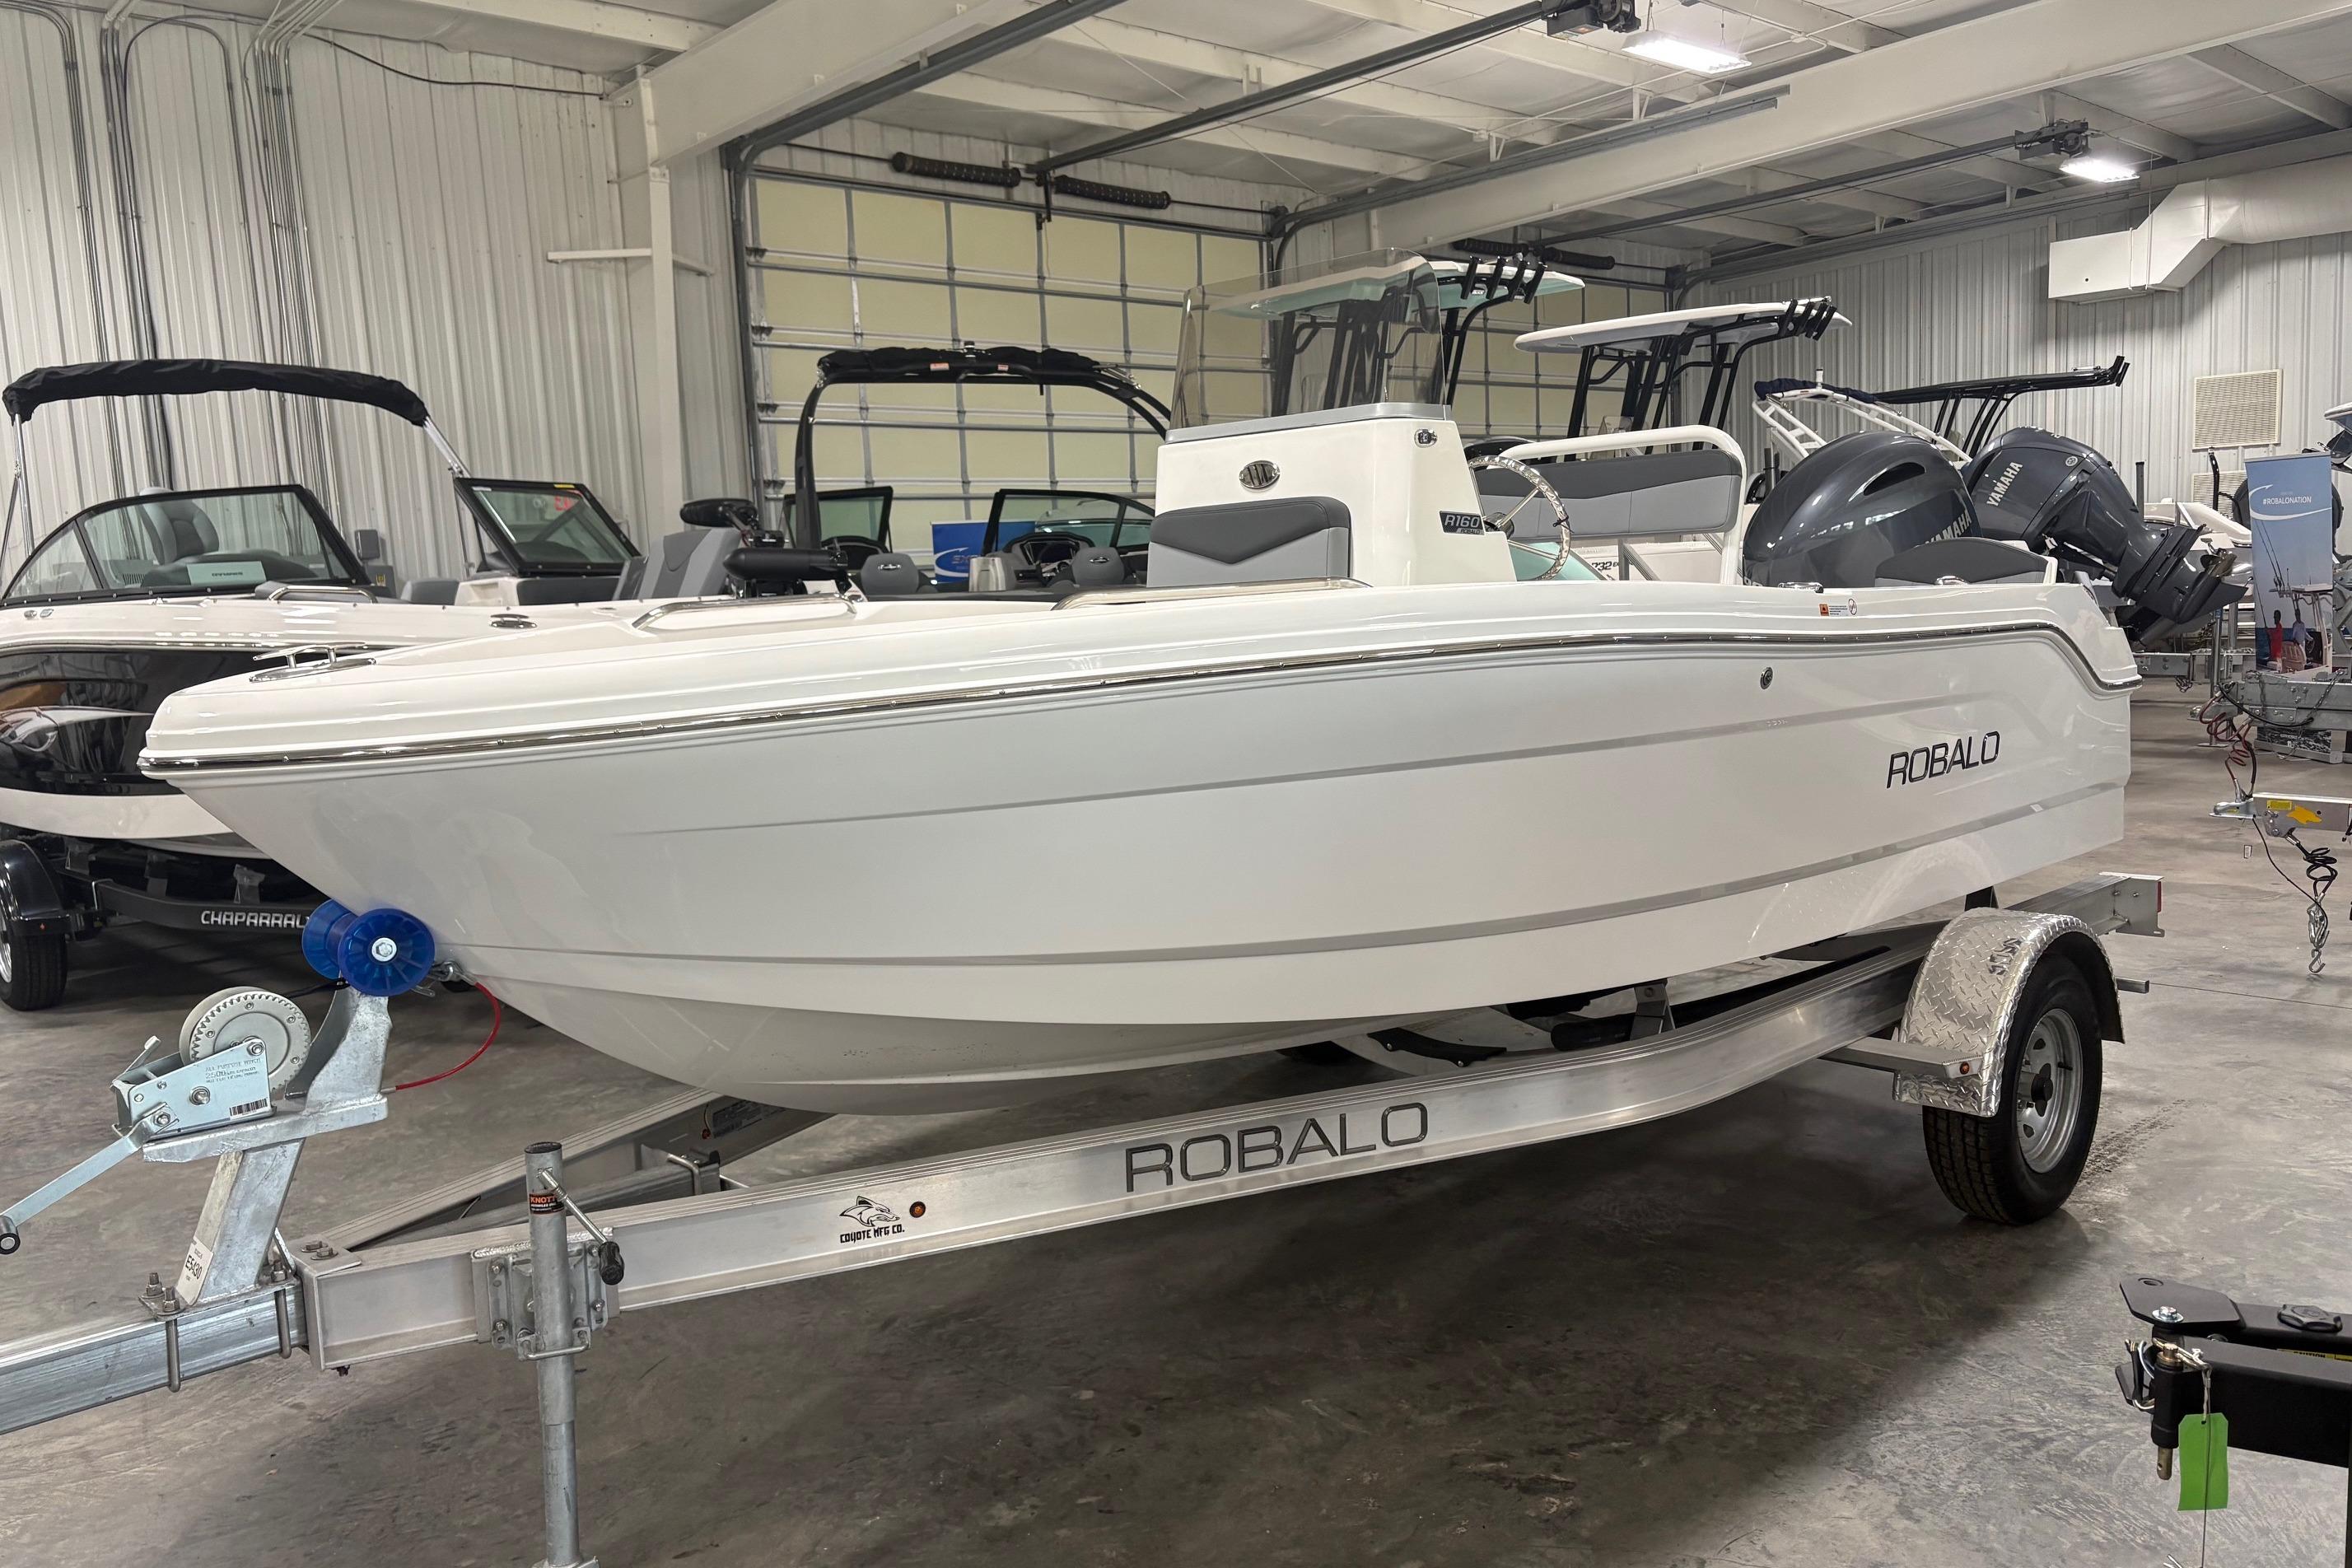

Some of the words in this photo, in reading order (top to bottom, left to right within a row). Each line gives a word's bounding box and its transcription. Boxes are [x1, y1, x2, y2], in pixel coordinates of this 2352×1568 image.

[1986, 462, 2023, 506] YAMAHA
[2262, 496, 2312, 505] #ROBALONATION
[1444, 515, 1481, 528] R160
[1886, 730, 2000, 789] ROBALO
[200, 910, 306, 929] CHAPARRAL
[1125, 1102, 1428, 1192] ROBALO
[839, 1229, 872, 1244] COYOTE
[873, 1225, 890, 1238] MFG
[892, 1224, 905, 1234] CO.
